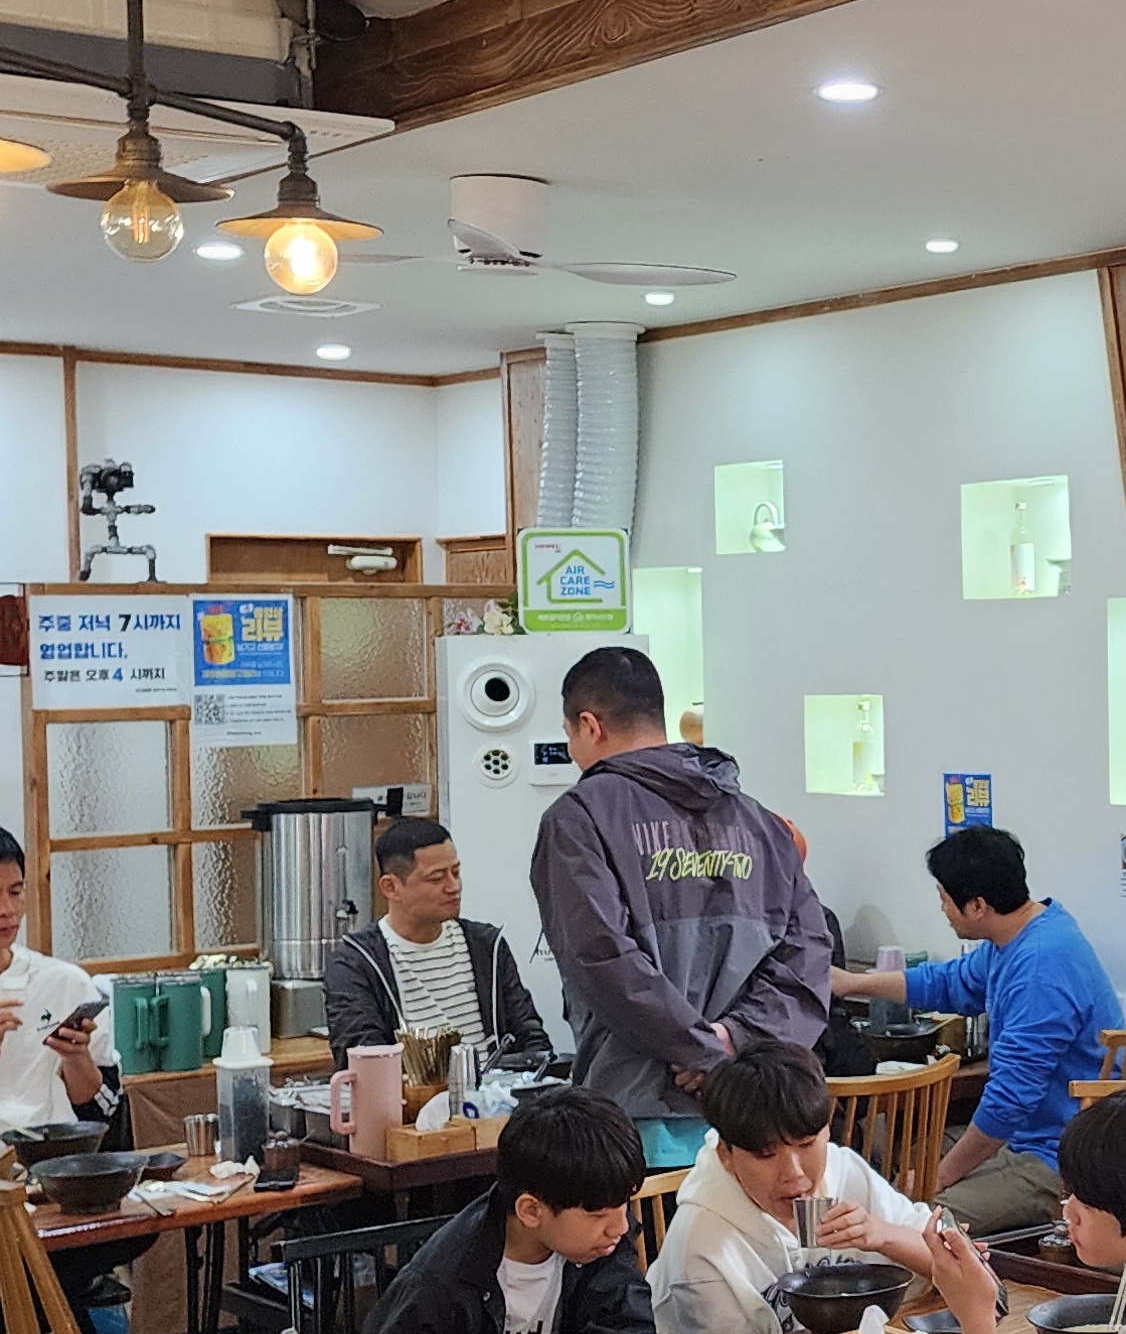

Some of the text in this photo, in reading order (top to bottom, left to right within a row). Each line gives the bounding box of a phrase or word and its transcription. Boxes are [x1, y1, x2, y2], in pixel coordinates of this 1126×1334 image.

[565, 566, 585, 575] AIR
[560, 576, 590, 585] CARE
[560, 587, 590, 595] ZONE
[78, 614, 111, 632] 저녁
